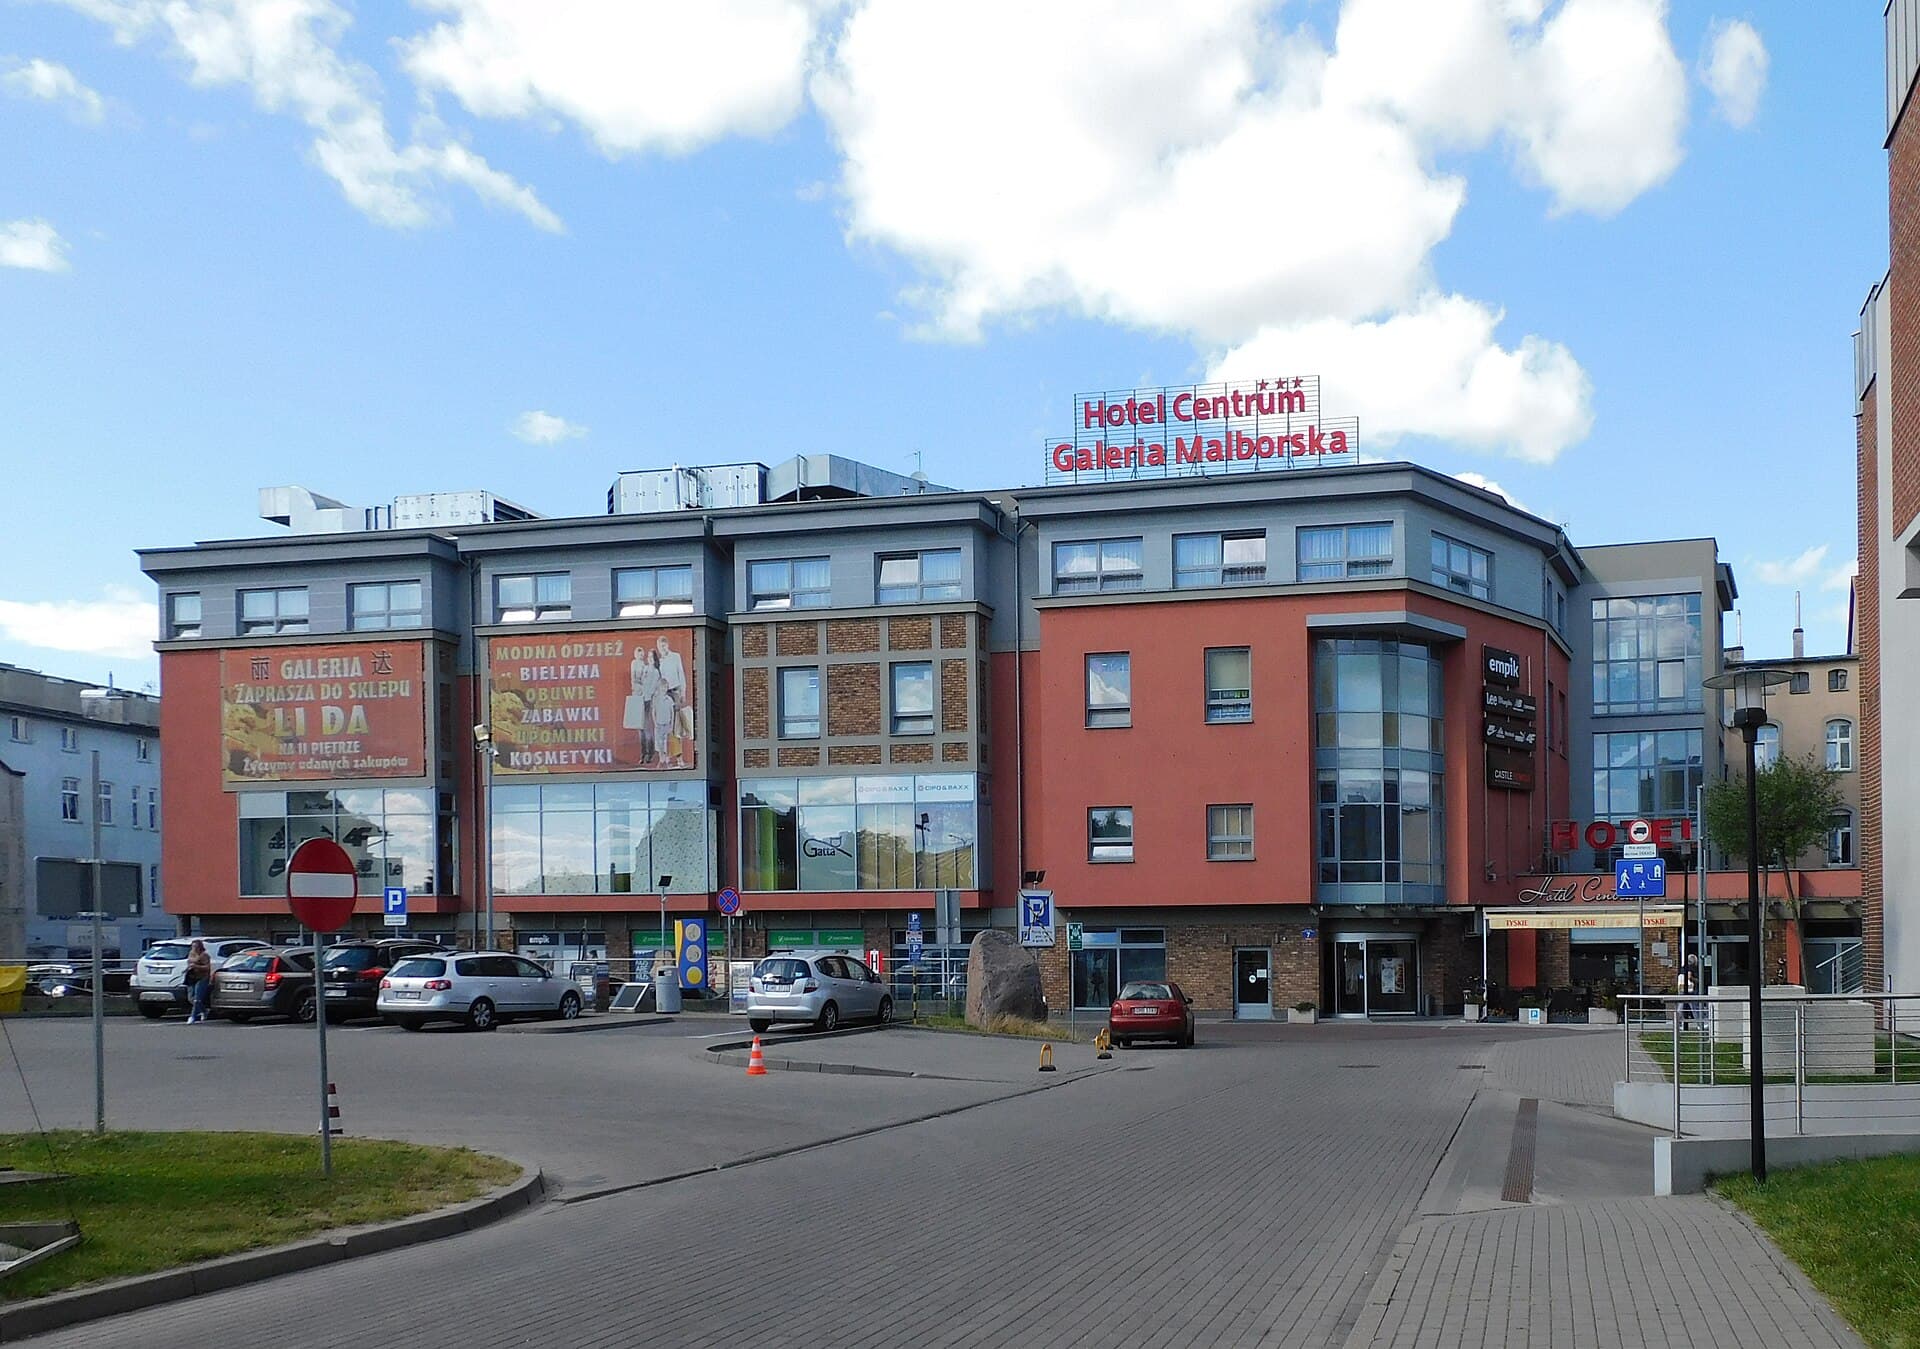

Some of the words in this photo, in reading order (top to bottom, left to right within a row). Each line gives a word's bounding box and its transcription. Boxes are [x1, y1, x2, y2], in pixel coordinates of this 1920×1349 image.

[1084, 394, 1166, 429] Hotel
[1172, 387, 1305, 422] Centrum
[1052, 438, 1166, 472] Galeria
[1175, 425, 1348, 464] Malborska
[496, 645, 557, 661] MODNA
[561, 641, 624, 658] ODZIEŻ
[280, 656, 363, 680] GALERIA
[520, 664, 600, 681] BIELIZNA
[1488, 657, 1519, 679] empik
[235, 683, 315, 704] ZAPRASZA
[320, 683, 343, 700] DO
[348, 679, 410, 699] SKLEPU
[525, 685, 595, 702] OBUWIE
[1486, 691, 1498, 707] Lee
[274, 706, 305, 737] LI
[321, 704, 369, 736] DA
[521, 706, 600, 724] ZABAWKI
[517, 727, 605, 745] UPOMINKI
[279, 742, 294, 756] NA
[311, 740, 361, 757] PIĘTRZE
[299, 756, 350, 771] udanych
[352, 755, 409, 770] zakupów
[510, 749, 613, 767] KOSMETYKI
[1494, 769, 1512, 781] CASTLE
[803, 838, 837, 857] Gatta
[1518, 876, 1577, 903] Hotel
[389, 890, 402, 912] P
[911, 913, 918, 922] P
[1029, 898, 1044, 924] P
[1506, 919, 1529, 927] TYSKIE
[1574, 919, 1597, 927] TYSKIE
[1643, 917, 1667, 926] TYSKIE
[528, 934, 550, 945] empik
[913, 944, 919, 953] P
